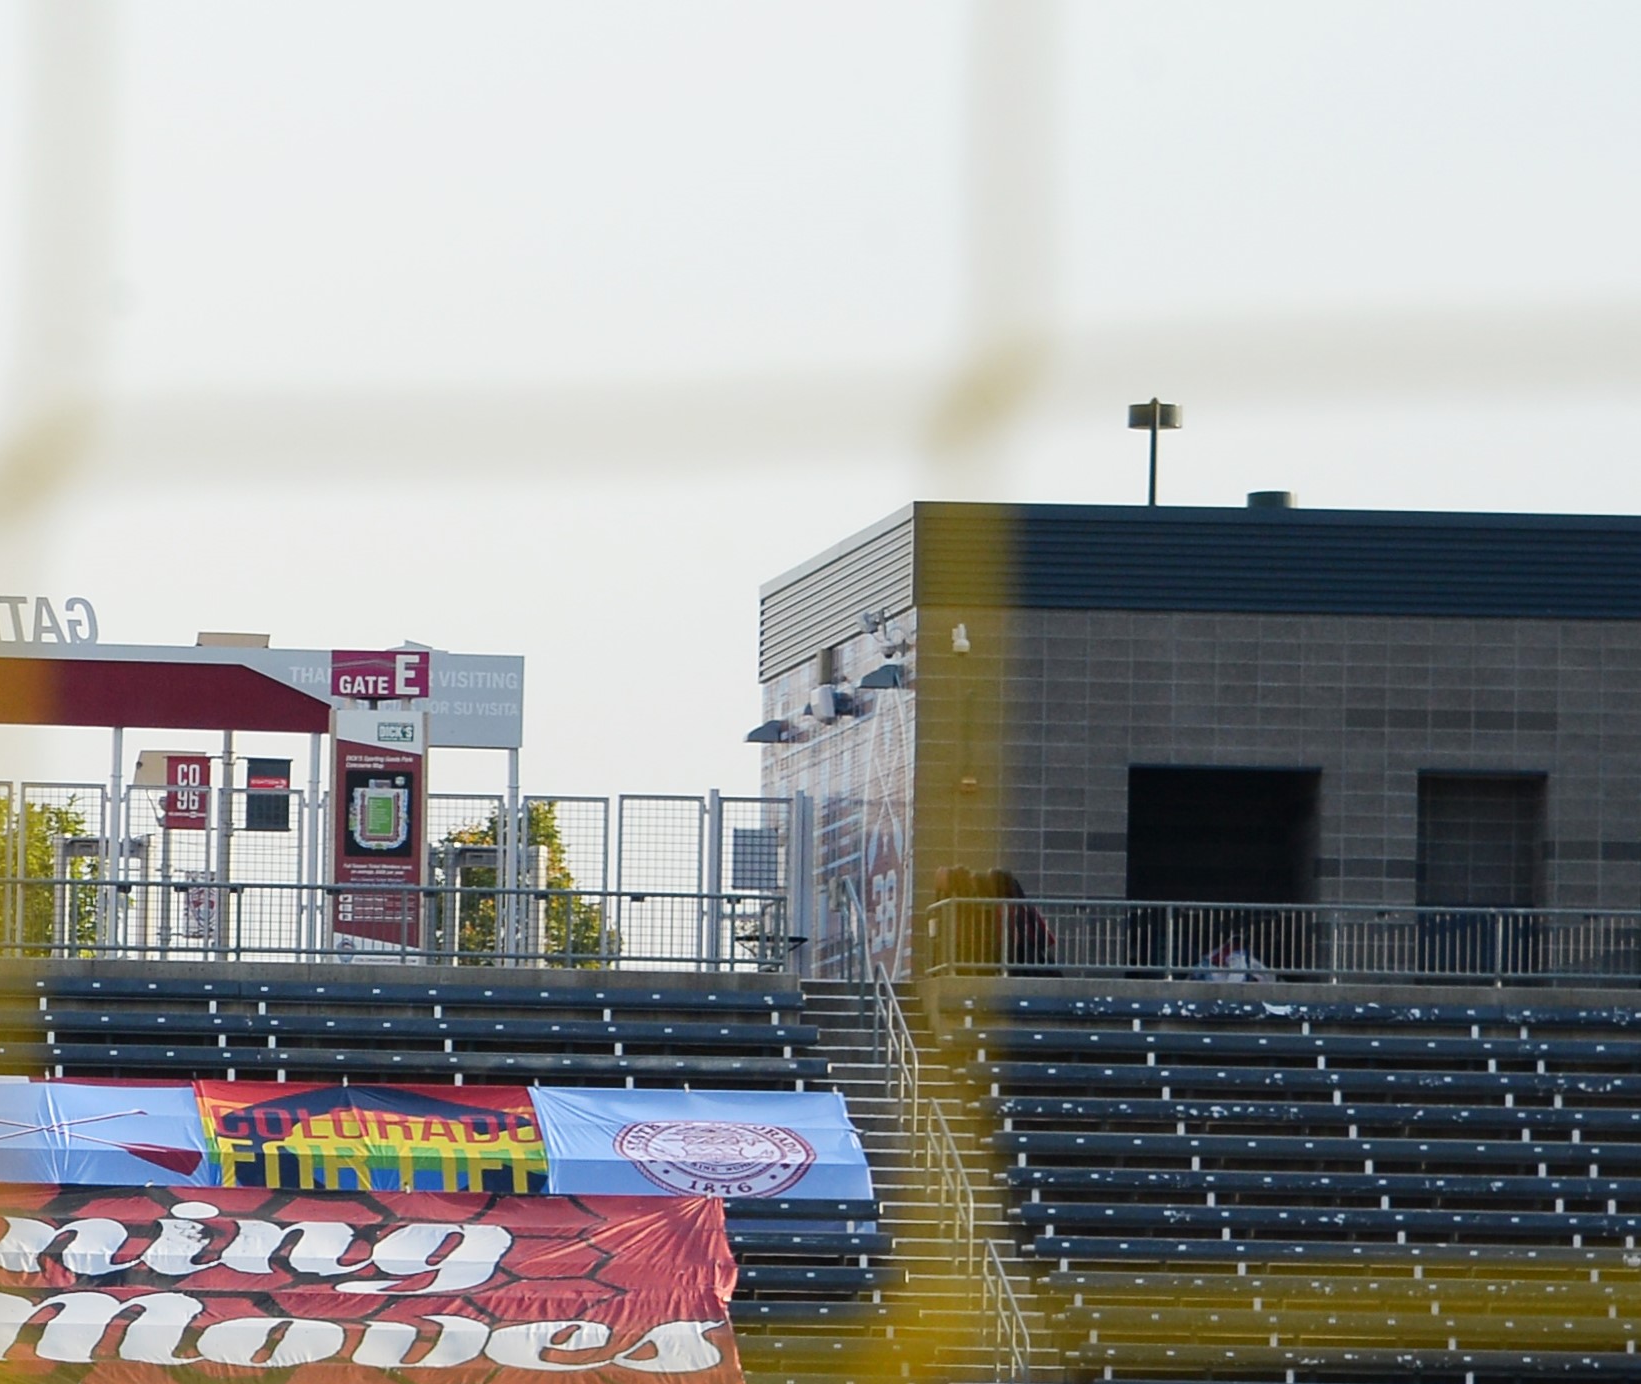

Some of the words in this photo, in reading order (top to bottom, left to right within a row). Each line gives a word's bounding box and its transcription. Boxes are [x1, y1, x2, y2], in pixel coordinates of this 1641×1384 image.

[289, 666, 332, 685] THA
[439, 671, 518, 690] VISITING
[339, 676, 389, 695] GATE
[395, 655, 420, 696] E
[177, 764, 200, 786] CO
[176, 788, 200, 810] 96
[213, 1104, 543, 1144] COLORADO
[687, 1180, 753, 1195] 1876
